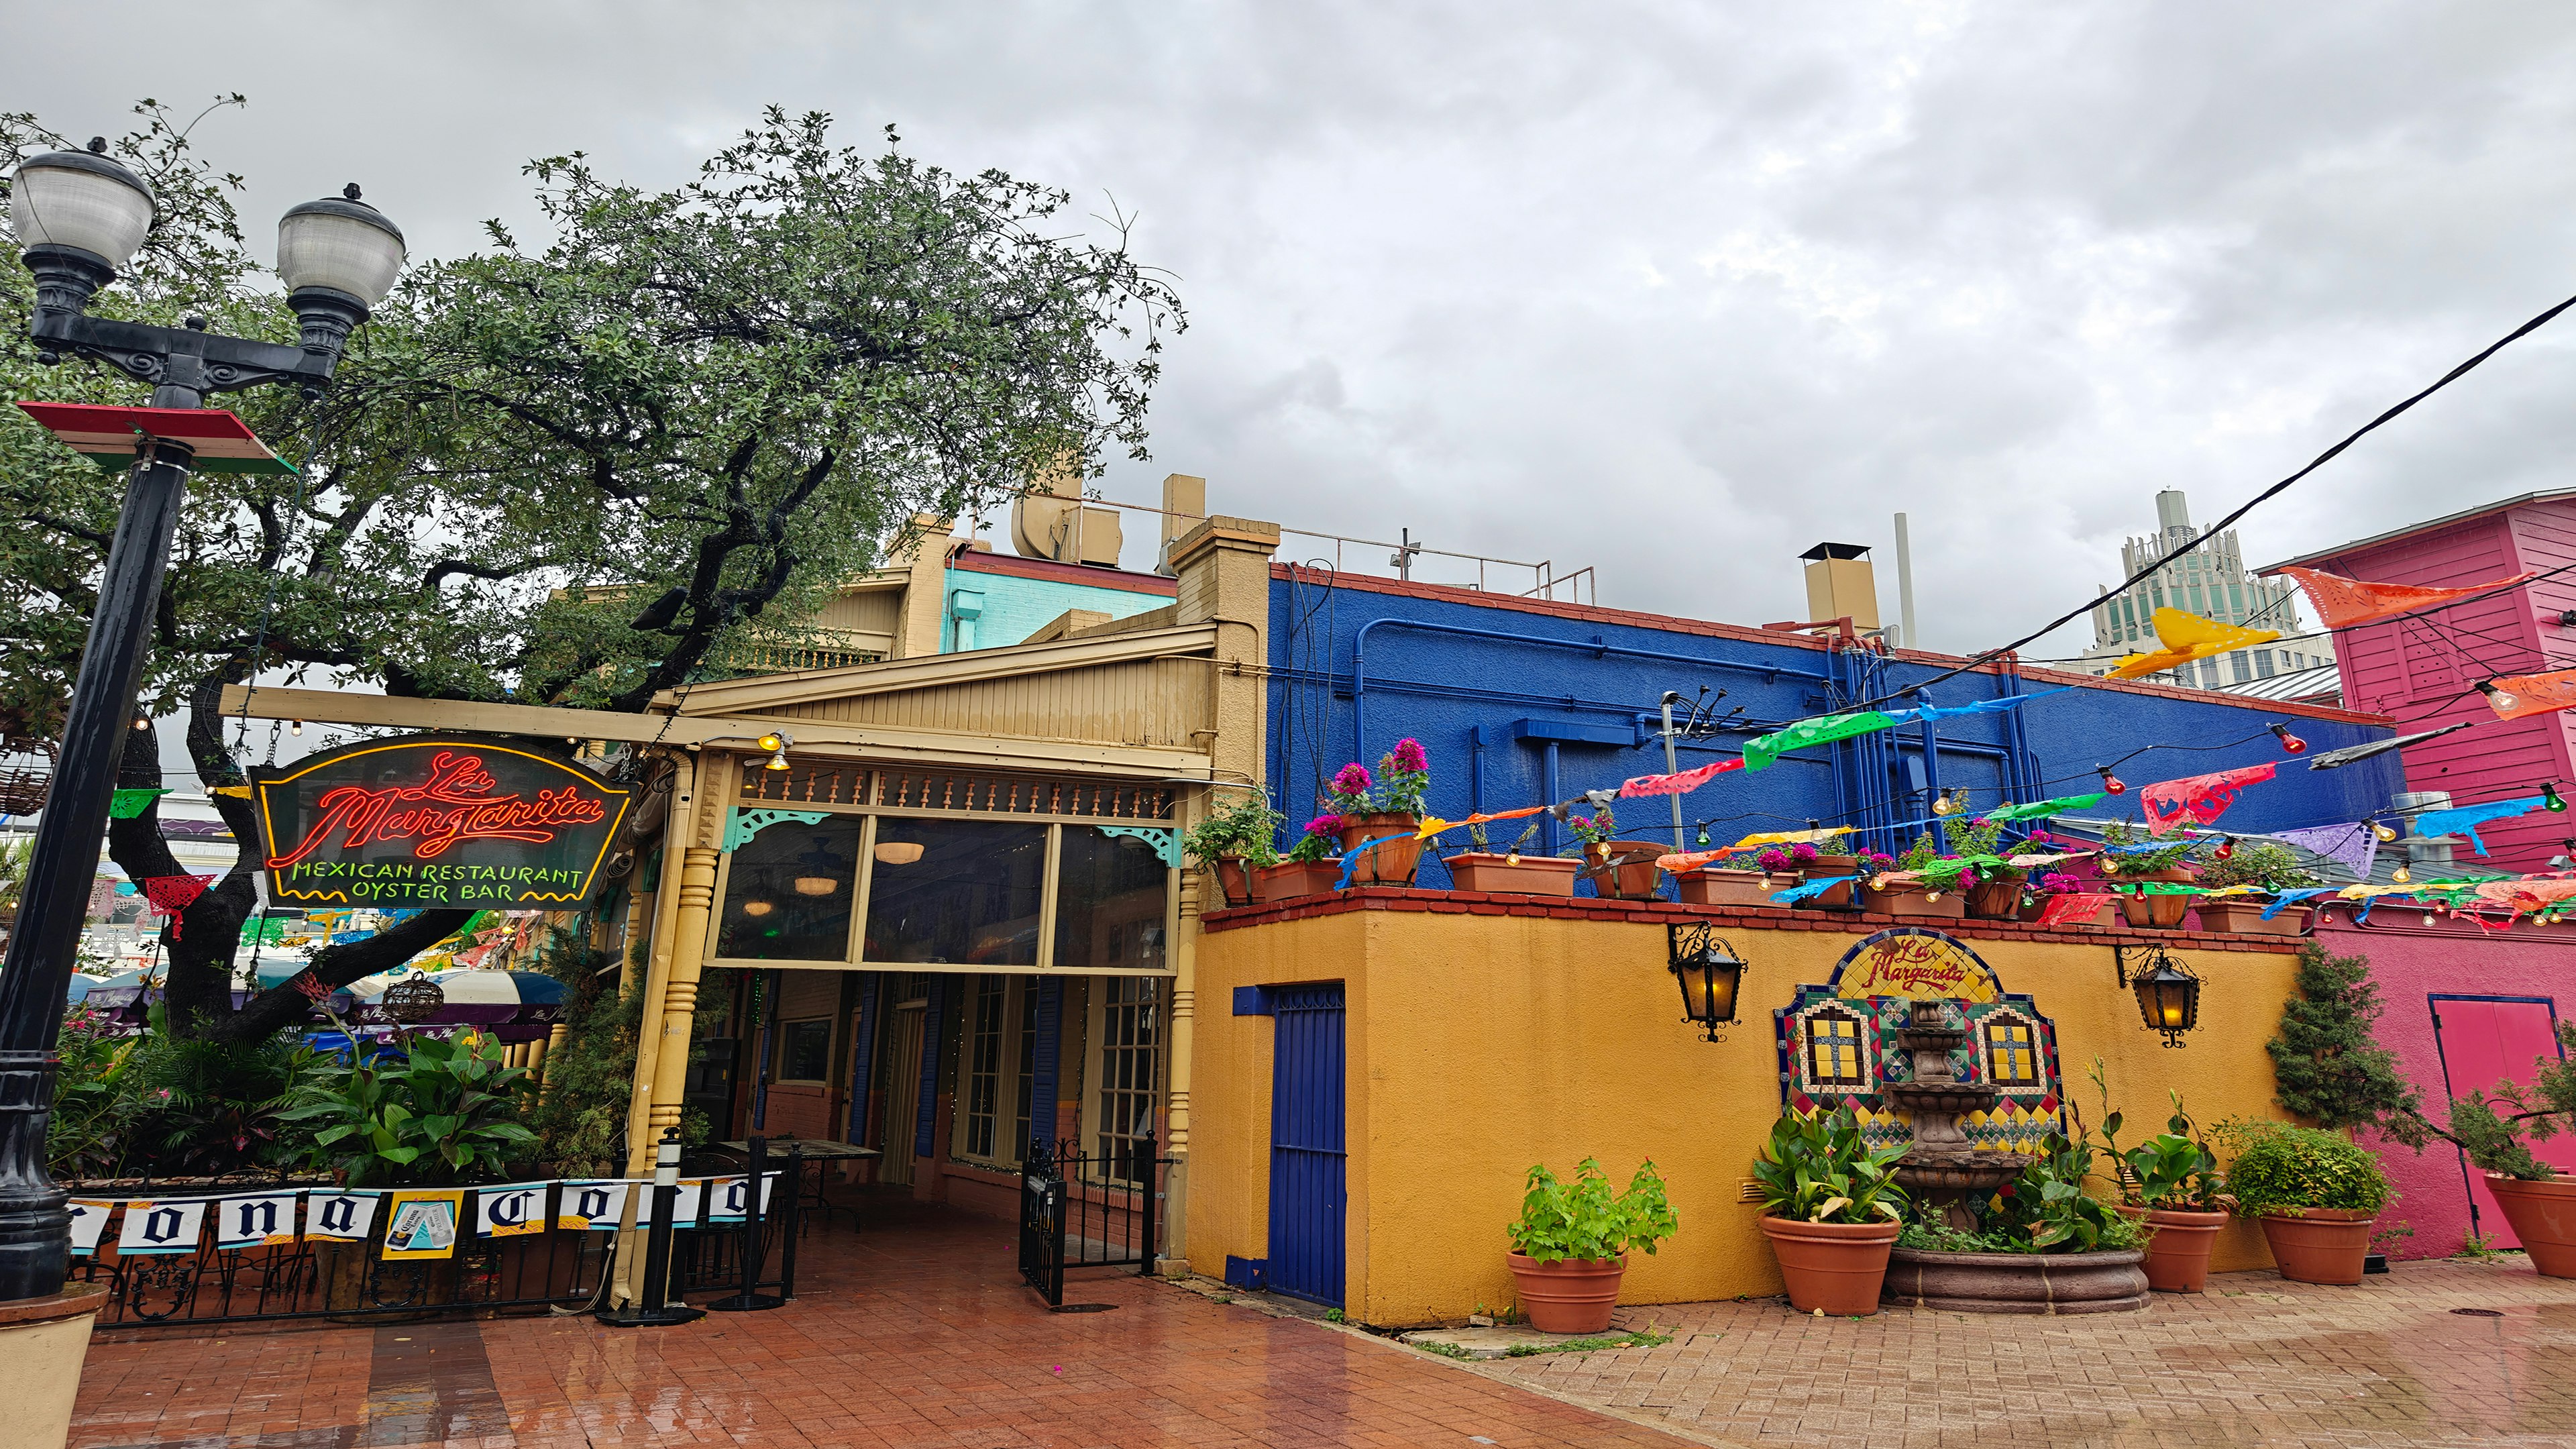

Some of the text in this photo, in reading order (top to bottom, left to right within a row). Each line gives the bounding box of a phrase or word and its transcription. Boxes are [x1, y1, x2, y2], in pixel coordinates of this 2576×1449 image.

[400, 751, 519, 804] La
[268, 786, 604, 867] Margarita
[292, 861, 583, 889] MEXICAN RESTAURANT
[352, 881, 513, 902] OYSTER BAR
[1894, 938, 1935, 963] La
[1862, 951, 1966, 992] Margarita
[530, 1009, 549, 1020] La
[401, 1210, 419, 1232] Corona
[432, 1209, 443, 1232] PREMIER
